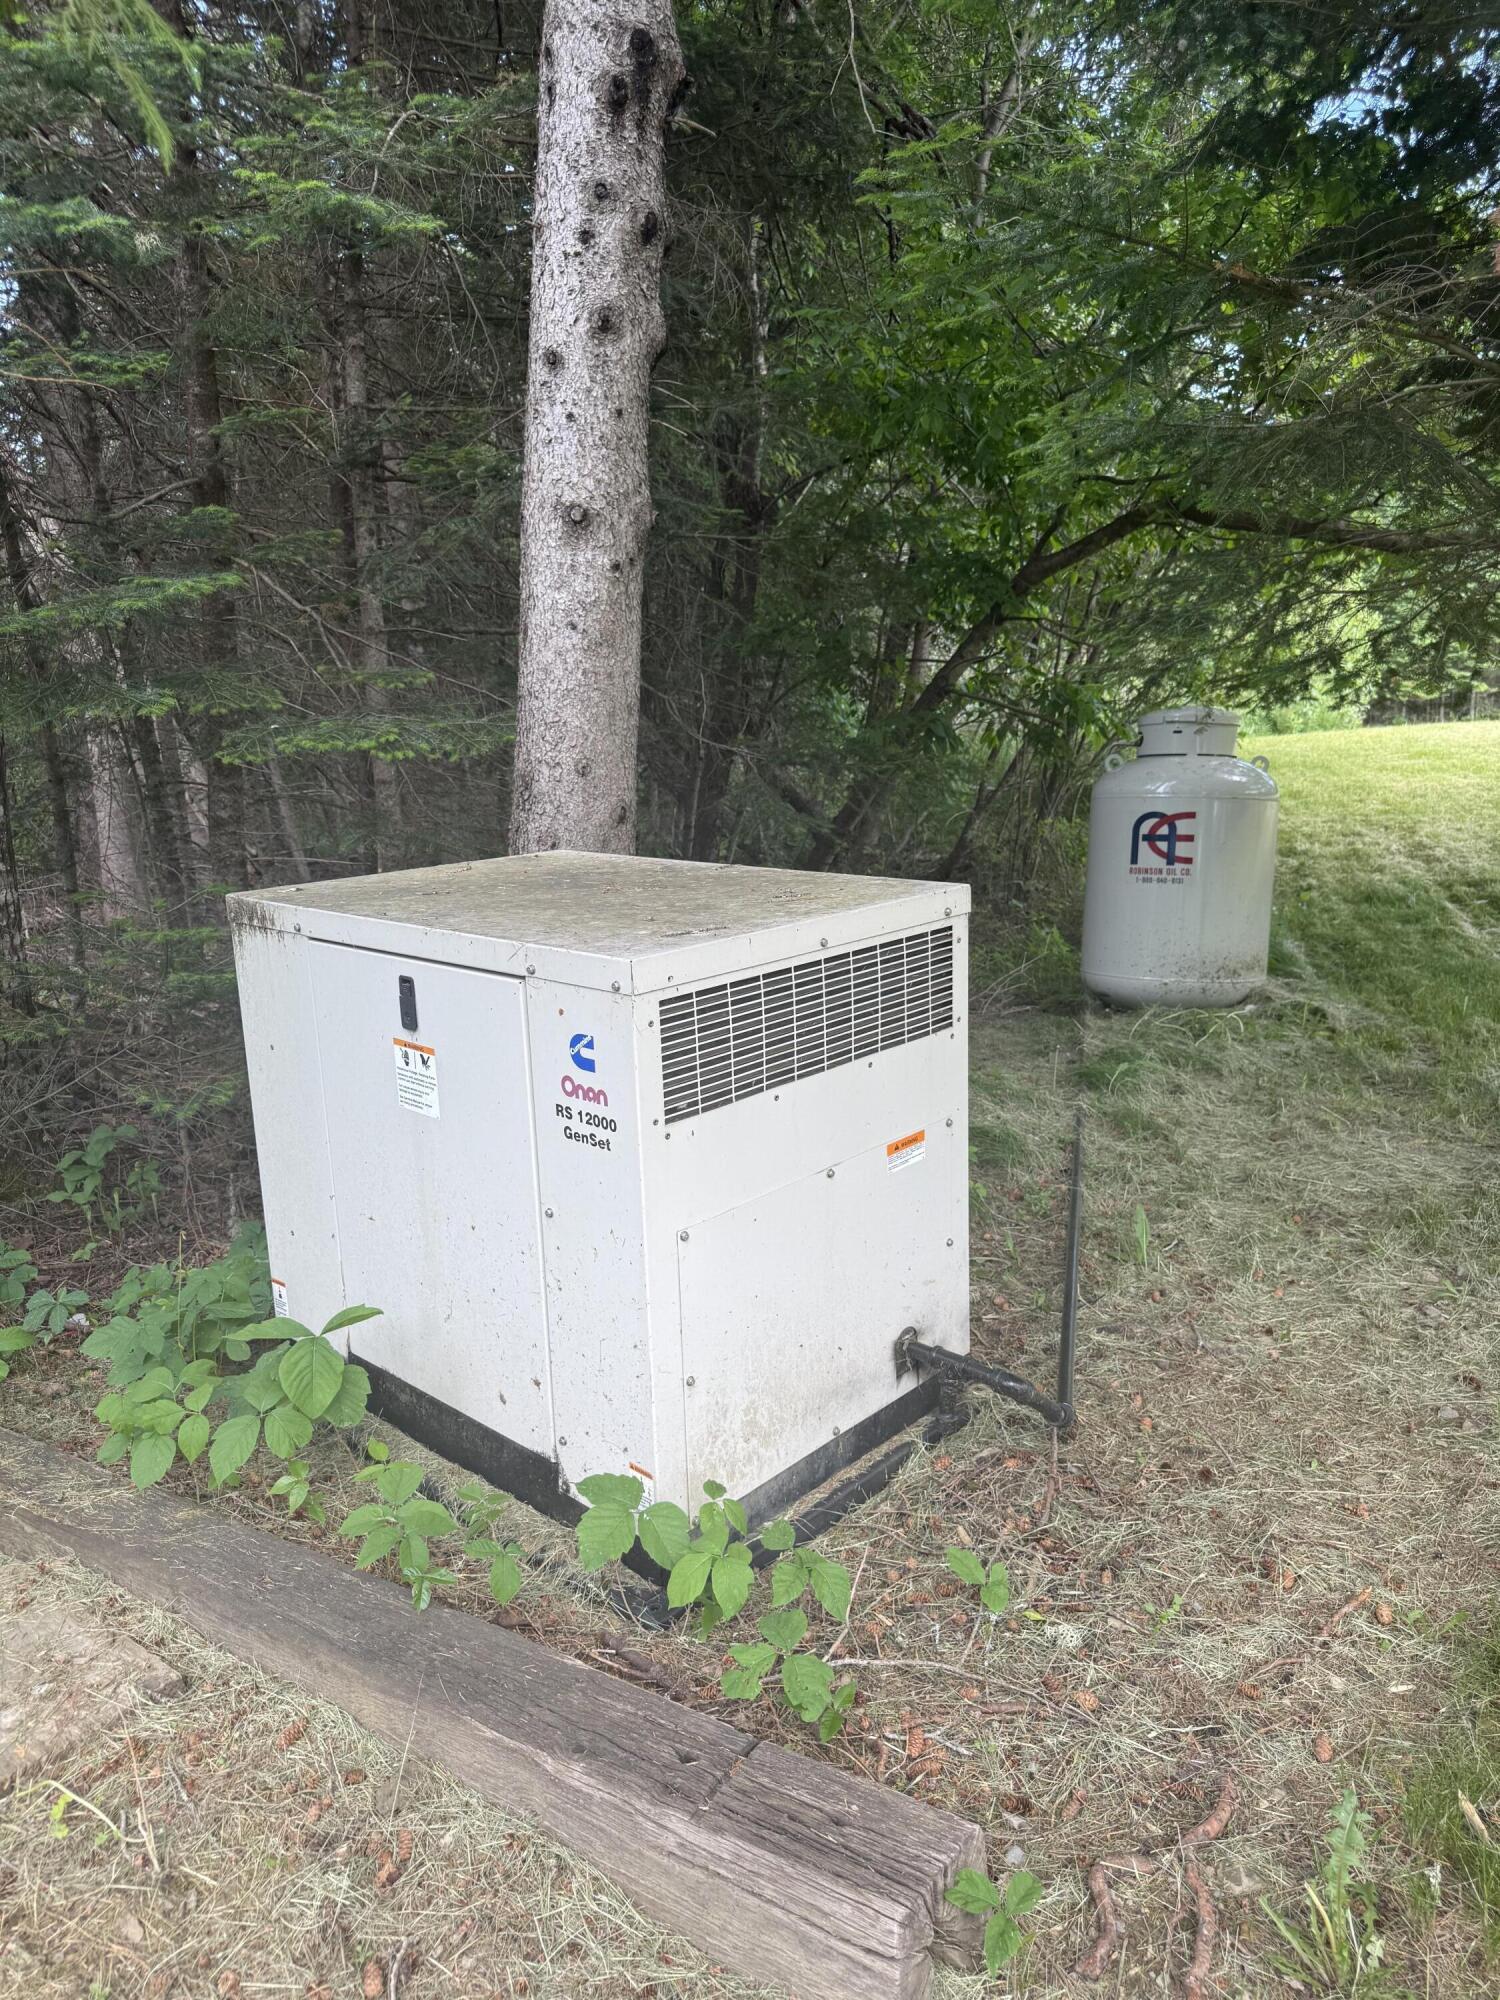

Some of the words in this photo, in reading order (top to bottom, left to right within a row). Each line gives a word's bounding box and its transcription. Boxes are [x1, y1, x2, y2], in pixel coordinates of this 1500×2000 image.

[1129, 867, 1163, 876] ROBINSON
[1166, 867, 1178, 876] OIL
[561, 1075, 609, 1107] Onan
[555, 1103, 573, 1120] RS
[577, 1110, 617, 1133] 12000
[563, 1126, 612, 1151] GenSet
